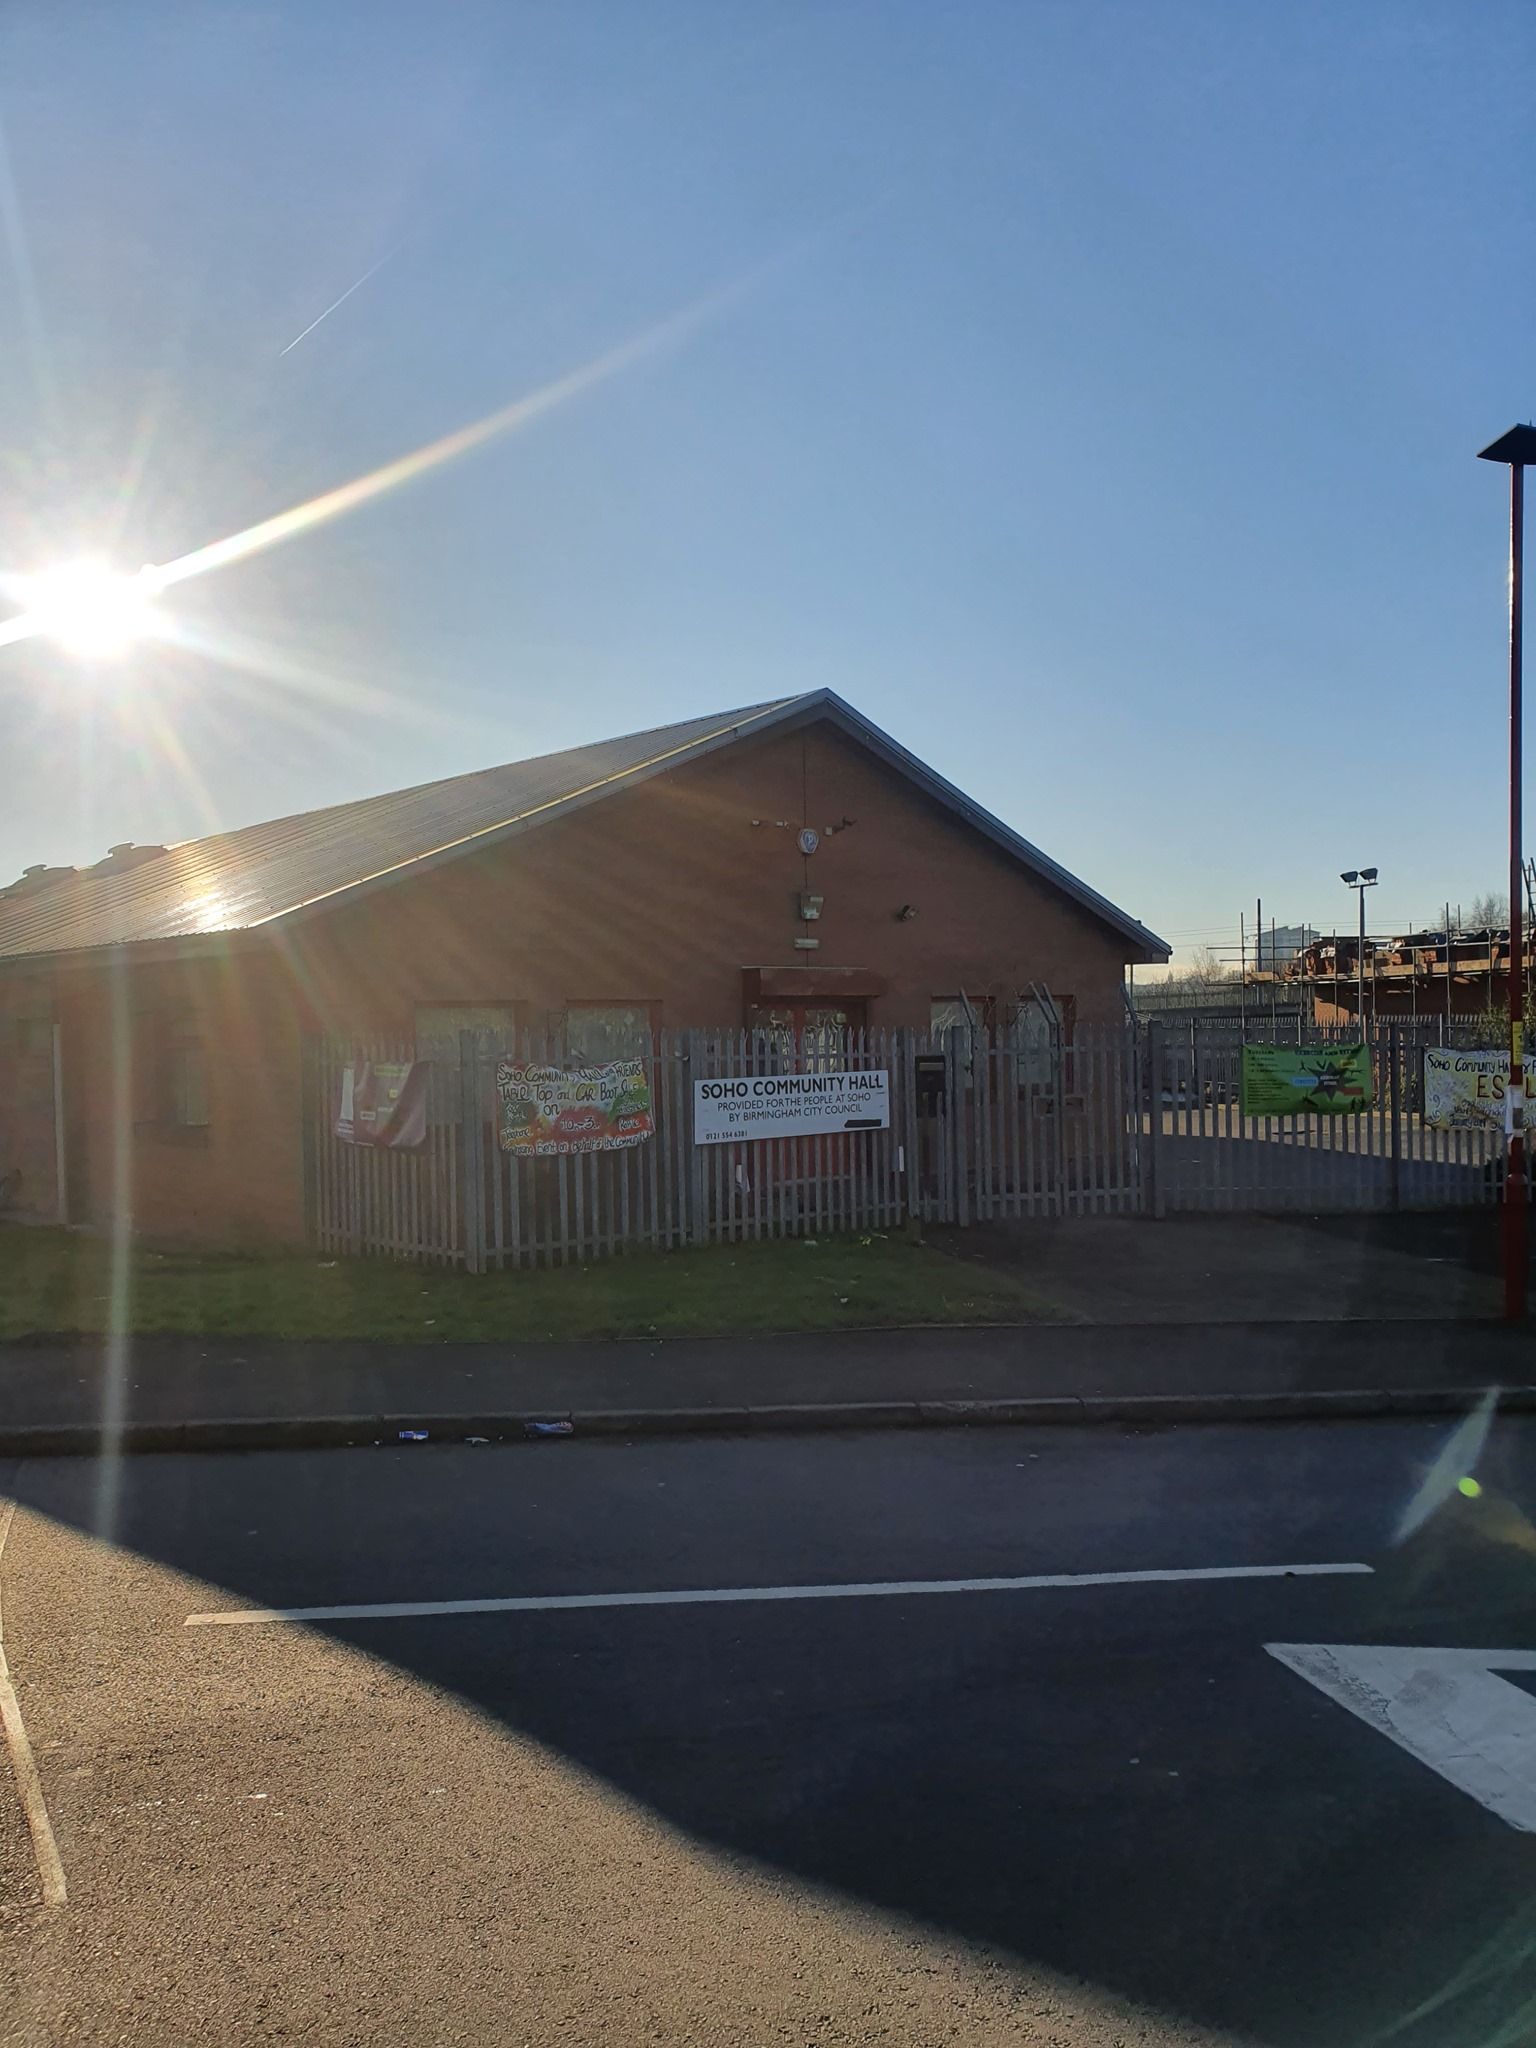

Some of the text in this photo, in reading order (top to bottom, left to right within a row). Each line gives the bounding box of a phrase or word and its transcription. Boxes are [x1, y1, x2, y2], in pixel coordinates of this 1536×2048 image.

[1498, 1059, 1512, 1073] HA
[702, 1075, 883, 1101] SOHO COMMUNITY HALL
[1477, 1074, 1536, 1100] ESL
[718, 1091, 870, 1114] PROVIDED FOR THE PEOPLE AT SOHO
[729, 1103, 862, 1124] BY BIRMINGHAM CITY COUNCIL
